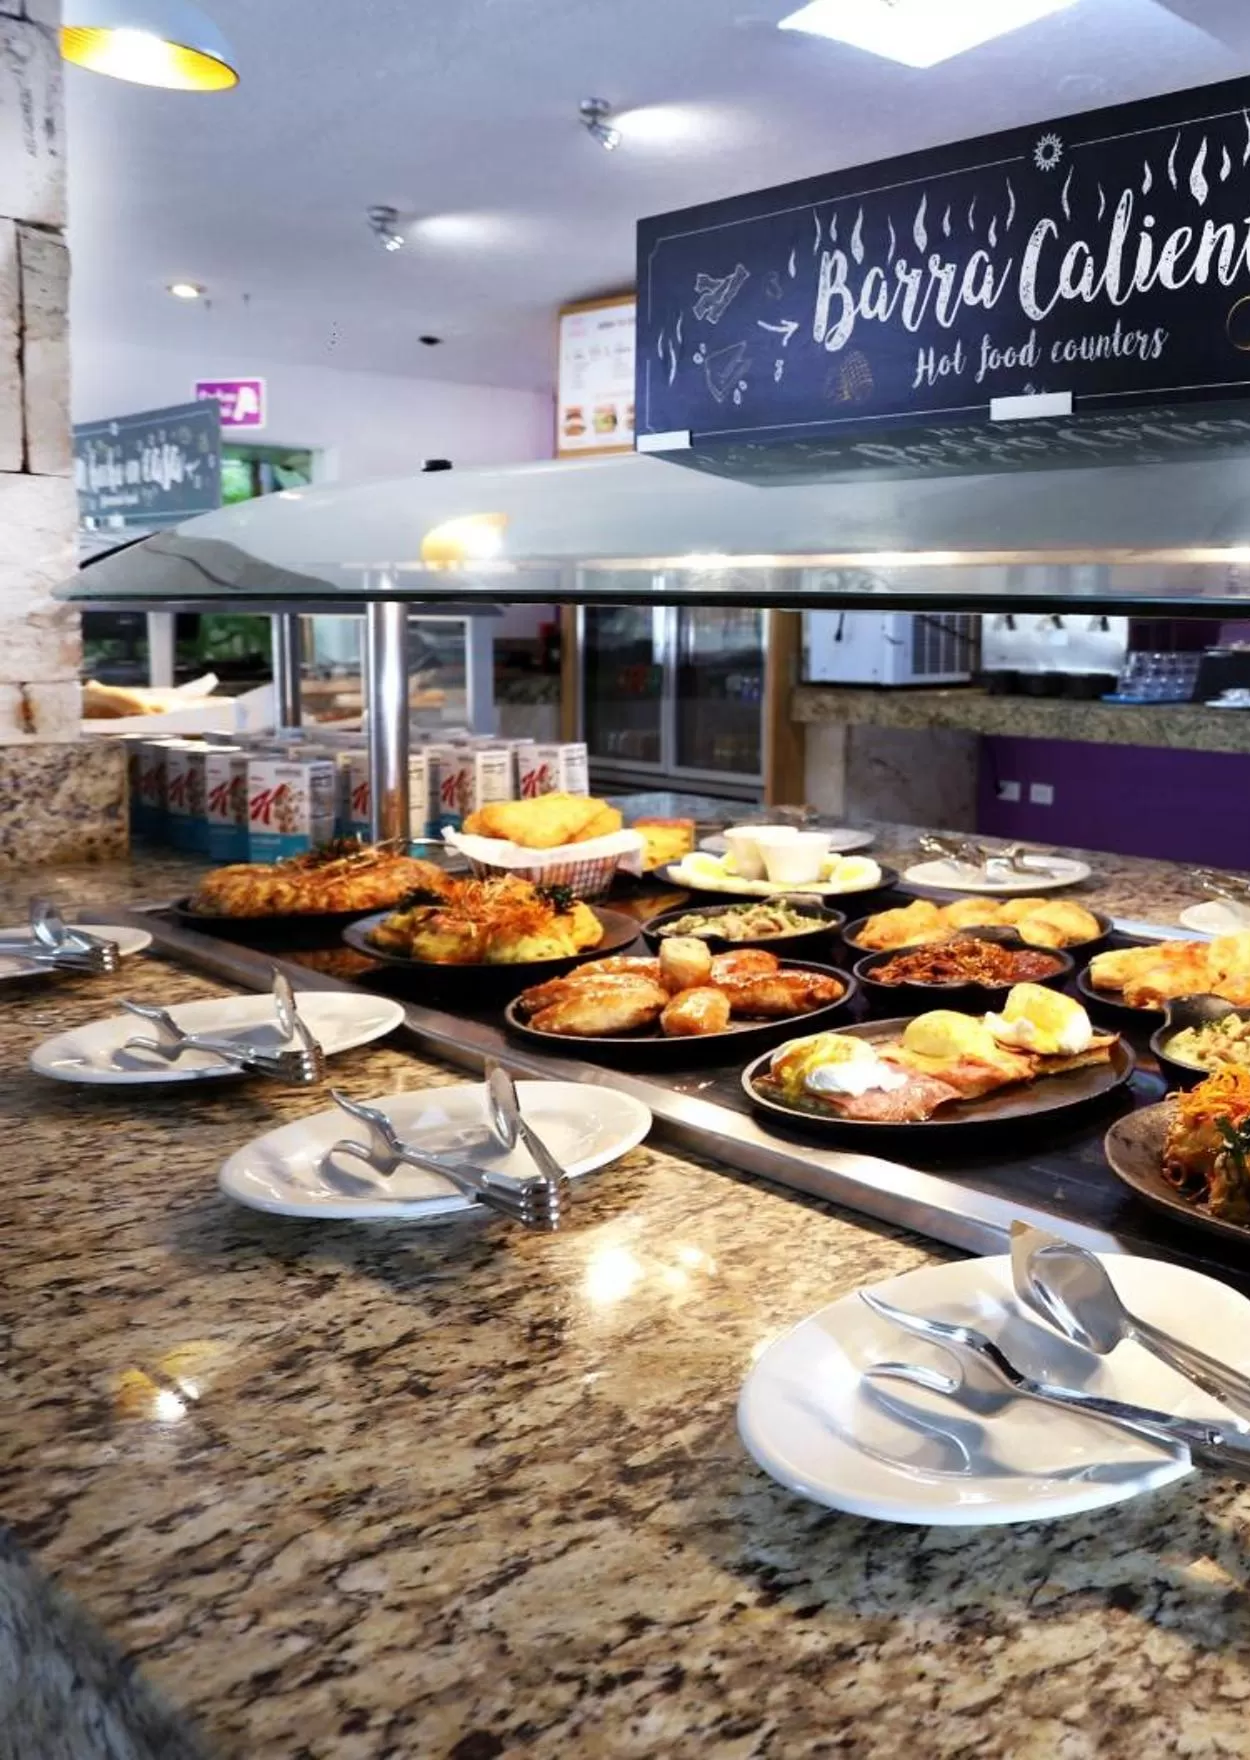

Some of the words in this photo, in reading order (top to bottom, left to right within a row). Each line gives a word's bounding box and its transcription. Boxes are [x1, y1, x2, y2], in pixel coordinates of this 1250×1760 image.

[813, 249, 1013, 352] Barra
[911, 338, 967, 388] Hot
[975, 328, 1041, 384] food
[1051, 319, 1169, 363] counters
[249, 783, 288, 825] K
